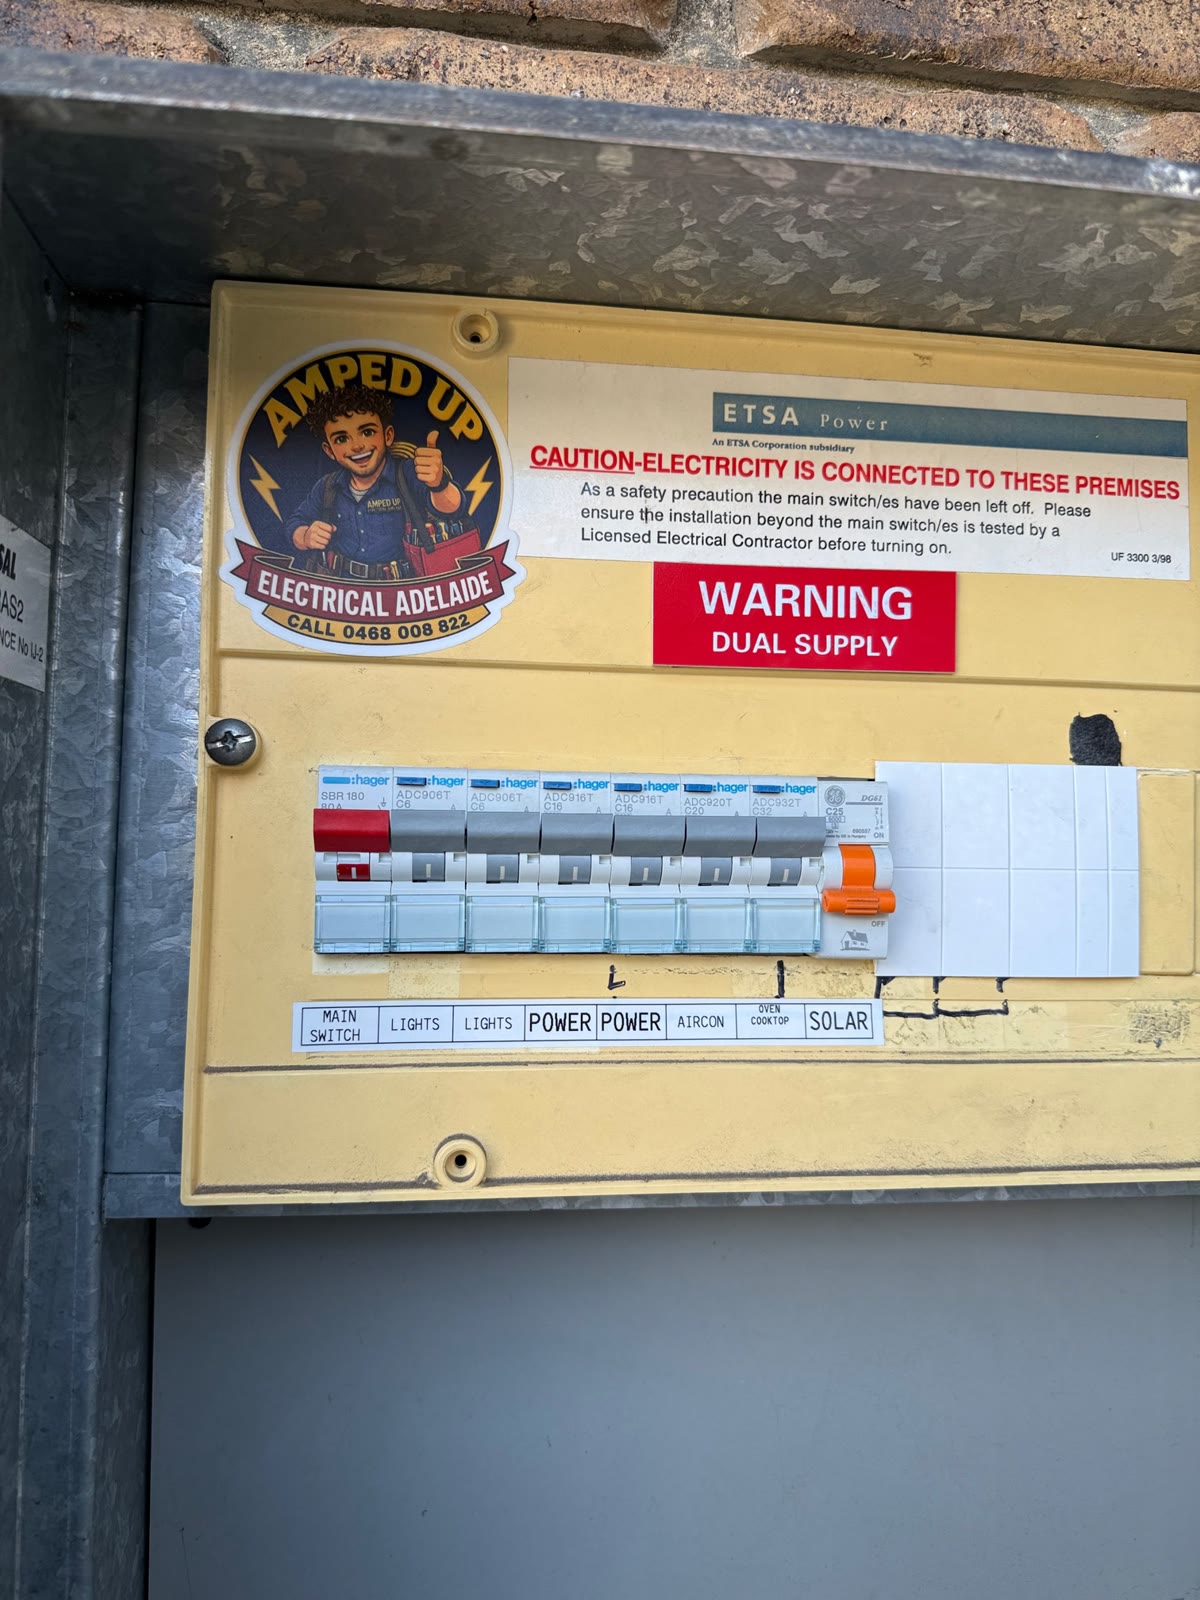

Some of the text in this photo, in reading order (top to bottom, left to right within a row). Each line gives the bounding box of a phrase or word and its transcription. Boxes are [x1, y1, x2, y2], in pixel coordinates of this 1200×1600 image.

[262, 354, 483, 448] AMPED UP
[723, 403, 888, 431] ETSA Power
[712, 438, 855, 454] An ETSA Corporation subsidiary
[530, 445, 1180, 500] CAUTION-ELECTRICITY IS CONNECTED TO THESE PREMISES
[367, 498, 391, 509] AMPED
[391, 498, 401, 506] UP
[581, 482, 1091, 517] As a safety precaution the main switch/es have been left off. Please
[581, 507, 1060, 539] ensure the installation beyond the main switch/es is tested by a
[581, 527, 952, 556] Licensed Electrical Contractor before turning on.
[1111, 552, 1172, 564] UF 3300 3/98
[257, 569, 493, 617] ELECTRICAL ADELAIDE
[0, 589, 24, 623] AS2
[698, 580, 913, 620] WARNING
[287, 613, 471, 641] CALL 0468 008 822
[18, 635, 29, 656] No
[712, 630, 898, 657] DUAL SUPPLY
[396, 790, 451, 800] ADC906T
[471, 792, 523, 802] ADC906T
[544, 792, 593, 802] ADC916T
[615, 794, 664, 804] ADC916T
[396, 800, 411, 809] C6
[470, 802, 485, 811] C6
[544, 802, 562, 811] C16
[614, 804, 633, 813] C16
[684, 798, 732, 807] ADC920T
[752, 798, 801, 808] ADC932T
[684, 807, 704, 815] C20
[752, 807, 772, 816] C32
[825, 807, 844, 816] C25
[758, 1004, 781, 1013] OVEN
[323, 1010, 357, 1023] MAIN
[529, 1012, 592, 1032] POWER
[600, 1012, 661, 1031] POWER
[677, 1015, 724, 1028] AIRCON
[750, 1015, 789, 1026] COOKTOP
[810, 1011, 868, 1031] SOLAR
[390, 1018, 440, 1031] LIGHTS
[464, 1017, 513, 1030] LIGHTS
[310, 1029, 361, 1042] SWITCH
